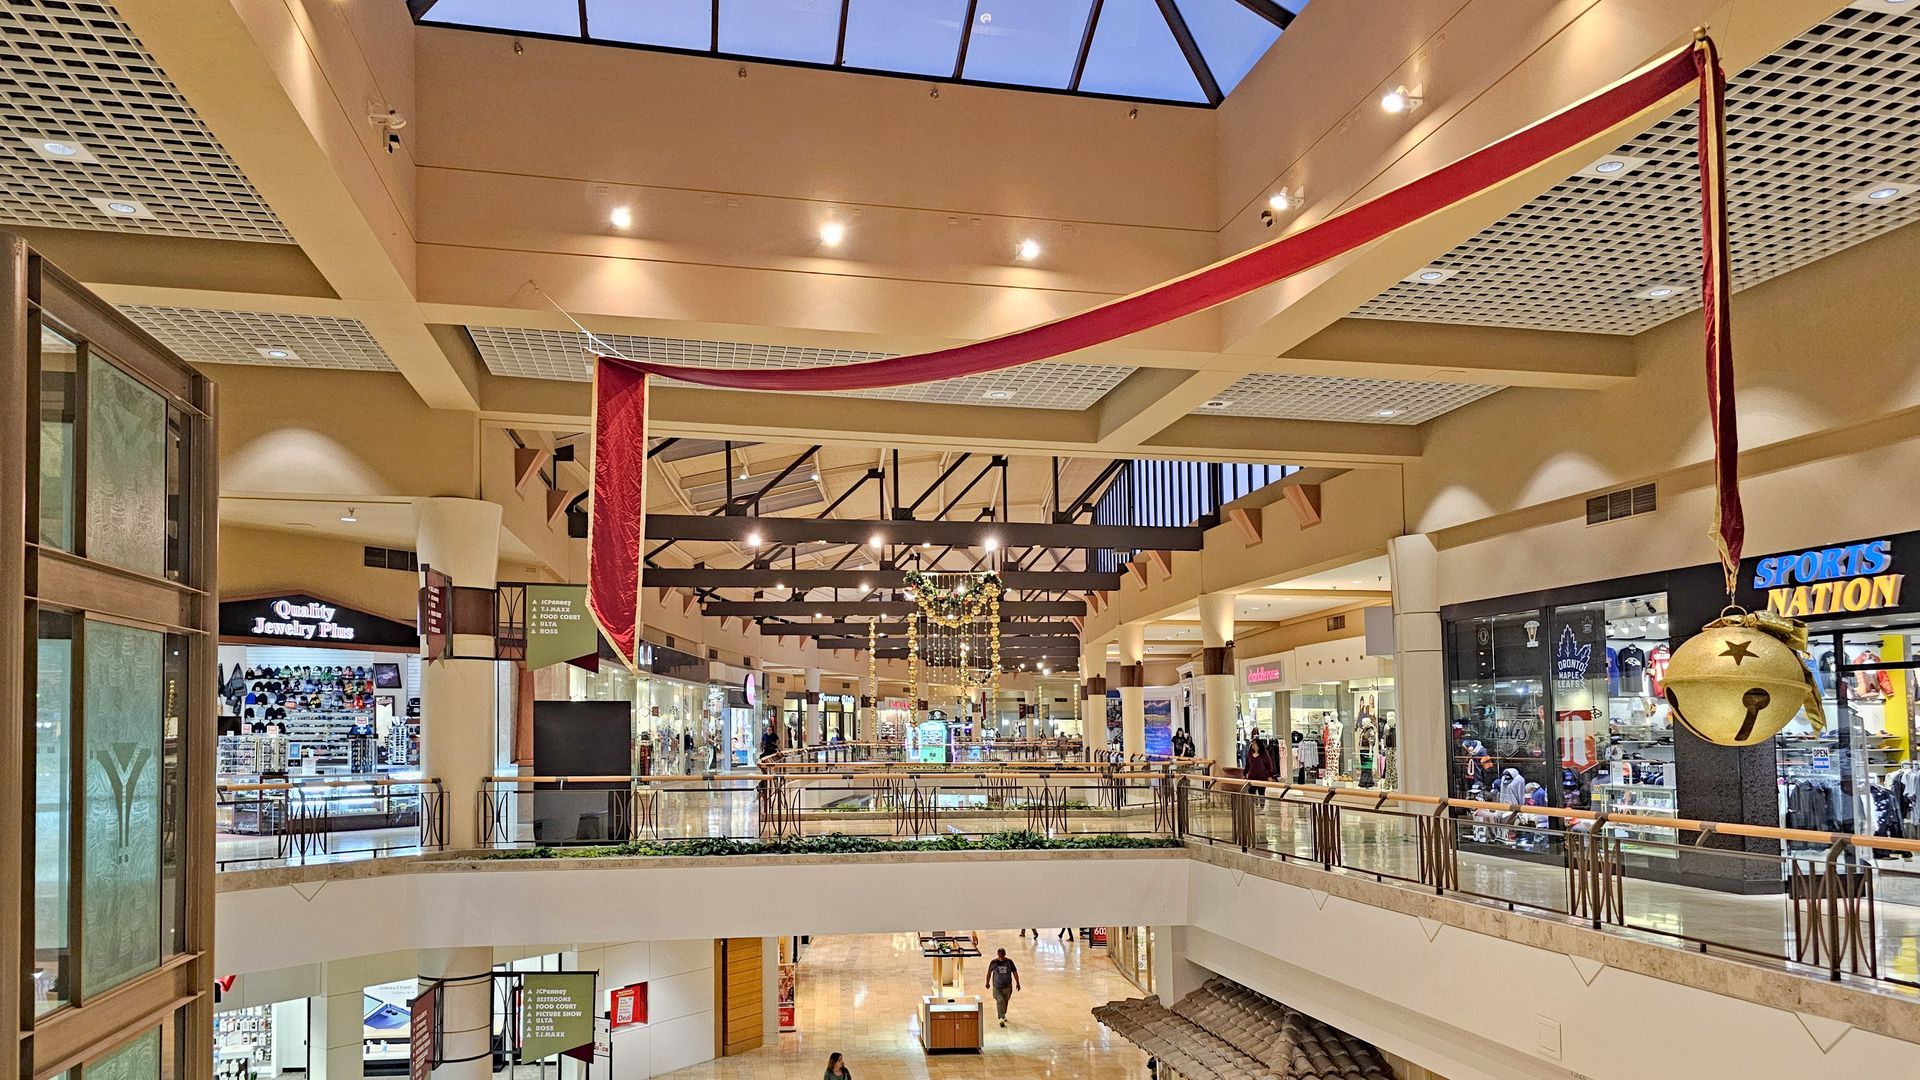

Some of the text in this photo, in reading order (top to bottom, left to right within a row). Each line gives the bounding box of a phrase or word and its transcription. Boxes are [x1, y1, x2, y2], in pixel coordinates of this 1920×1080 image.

[1754, 541, 1891, 588] SPORTS
[1768, 575, 1904, 617] NATION
[271, 600, 335, 622] Quality
[252, 618, 354, 640] Jewelry Plus
[1558, 671, 1580, 679] MAPLE
[1557, 680, 1580, 688] LEAFS
[1813, 748, 1828, 757] OPEN
[618, 1014, 631, 1022] Deal
